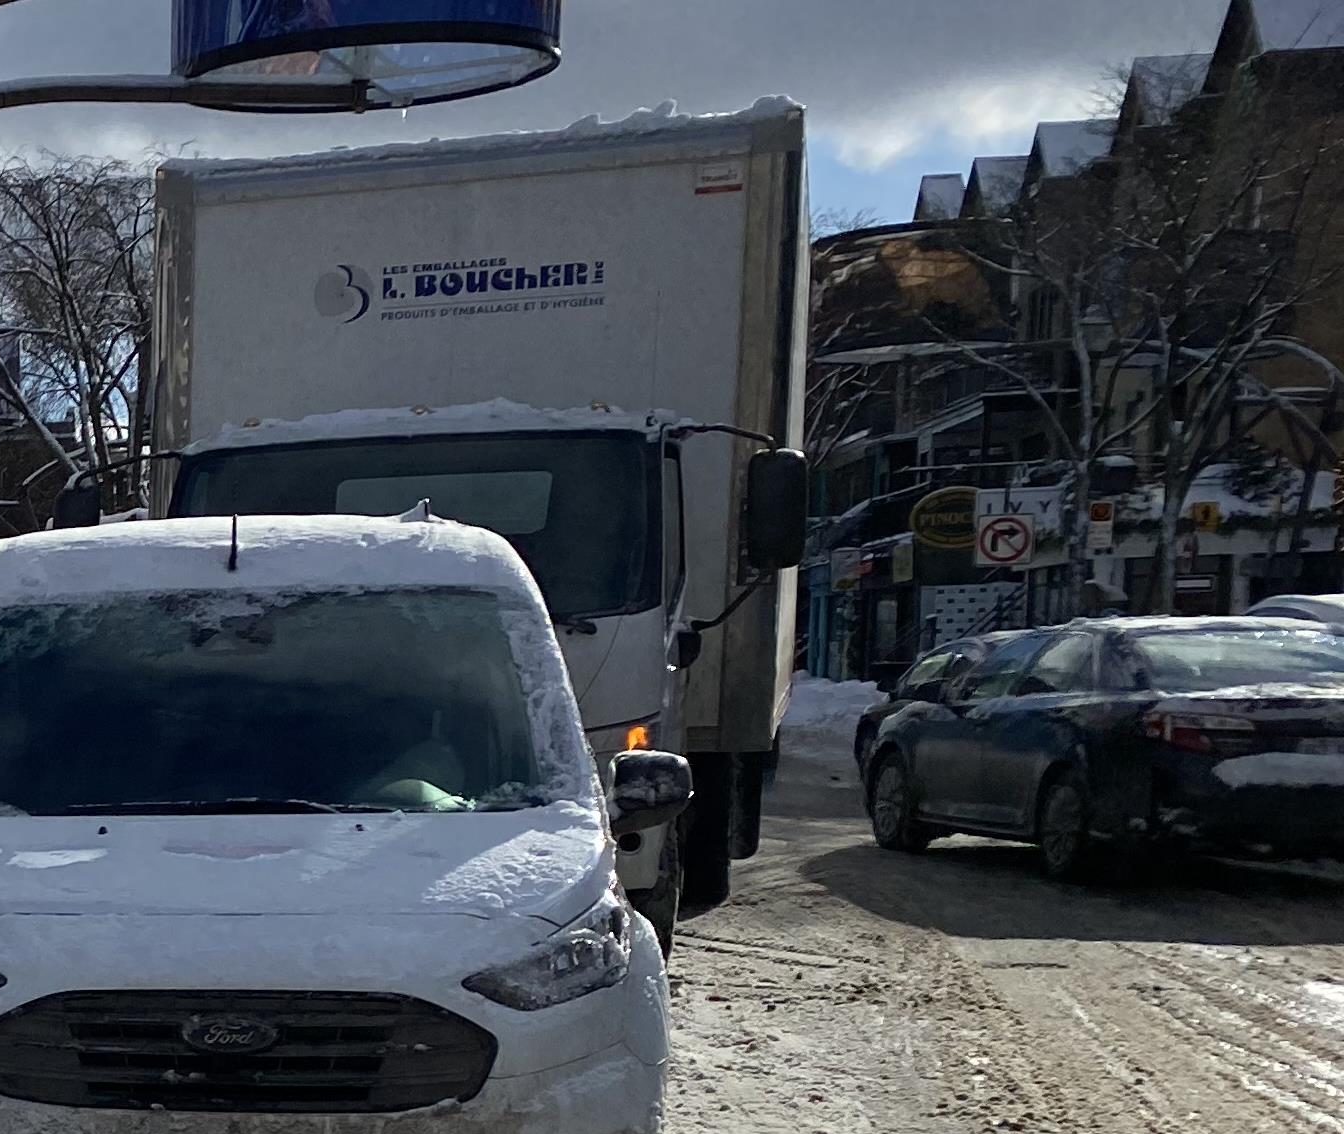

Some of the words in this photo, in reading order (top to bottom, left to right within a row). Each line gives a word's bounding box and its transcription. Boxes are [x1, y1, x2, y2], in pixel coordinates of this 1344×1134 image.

[382, 264, 408, 275] LES
[412, 257, 507, 273] EMBALLAGES
[381, 308, 437, 322] PRODUITS
[440, 302, 520, 317] D'EMBALLAGE
[523, 300, 537, 312] ET
[204, 1023, 255, 1044] Ford
